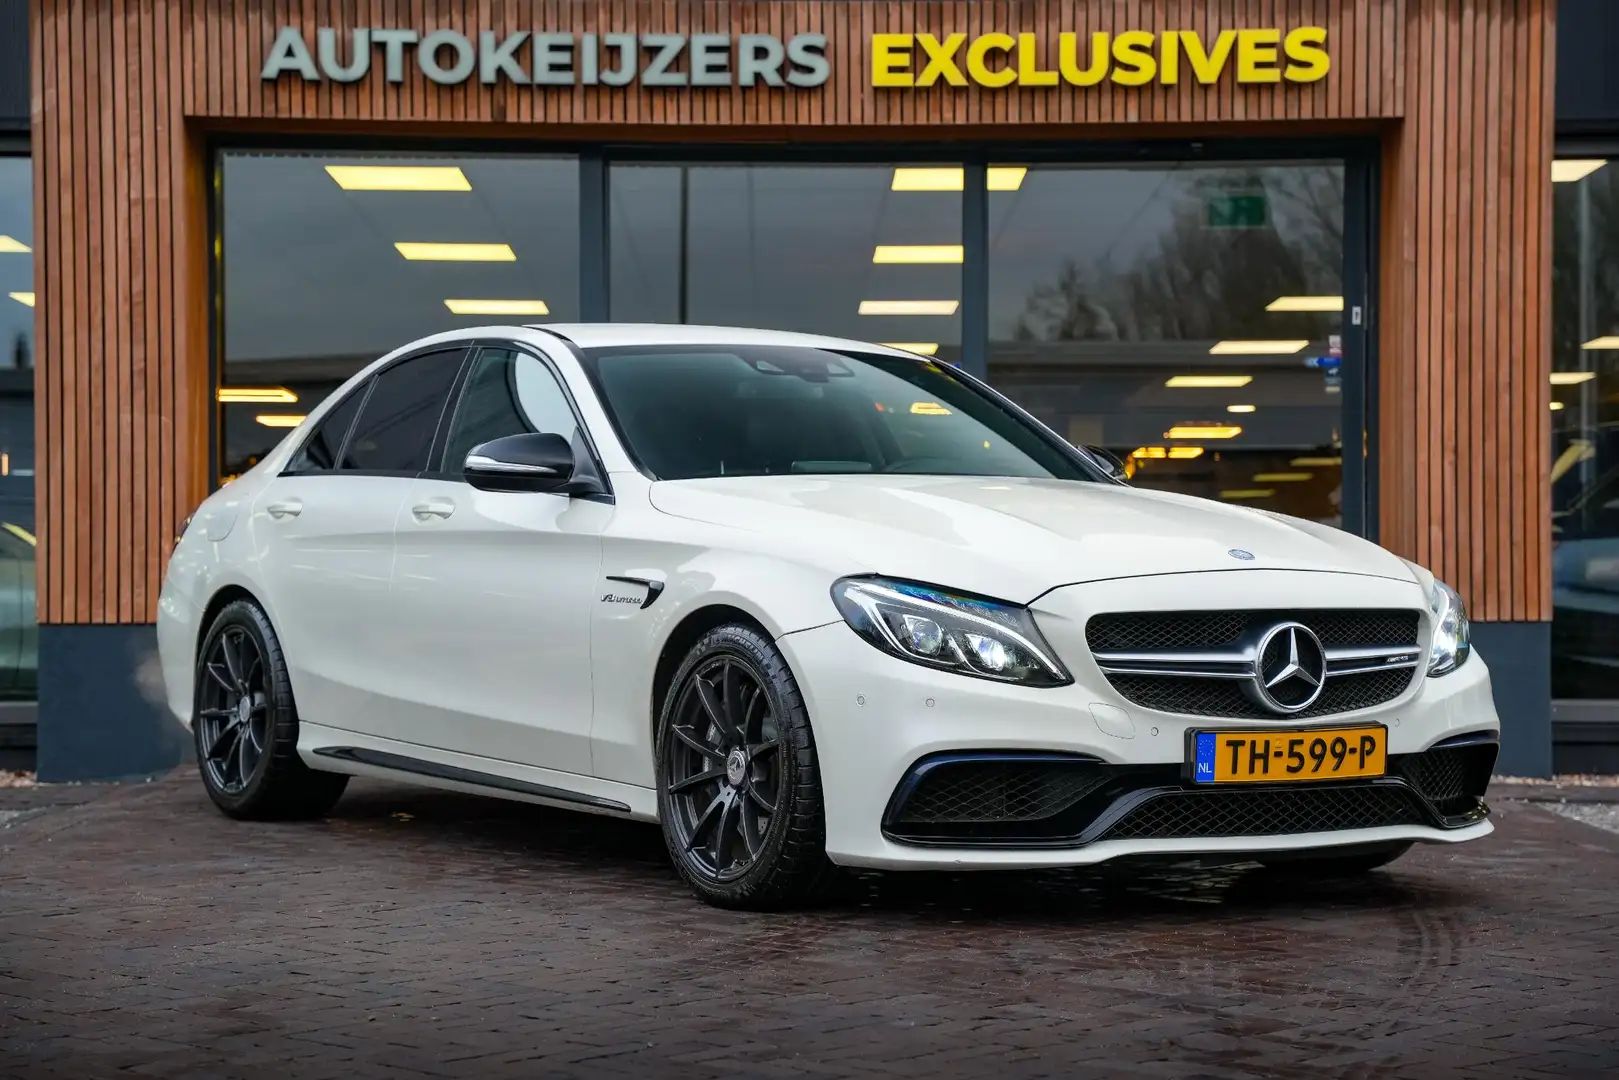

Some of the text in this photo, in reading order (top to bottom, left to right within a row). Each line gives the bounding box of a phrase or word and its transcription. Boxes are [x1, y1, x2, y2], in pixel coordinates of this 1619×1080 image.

[261, 26, 1331, 88] AUTOKEIJZERS EXCLUSIVES
[1198, 735, 1377, 775] NL TH-599-P
